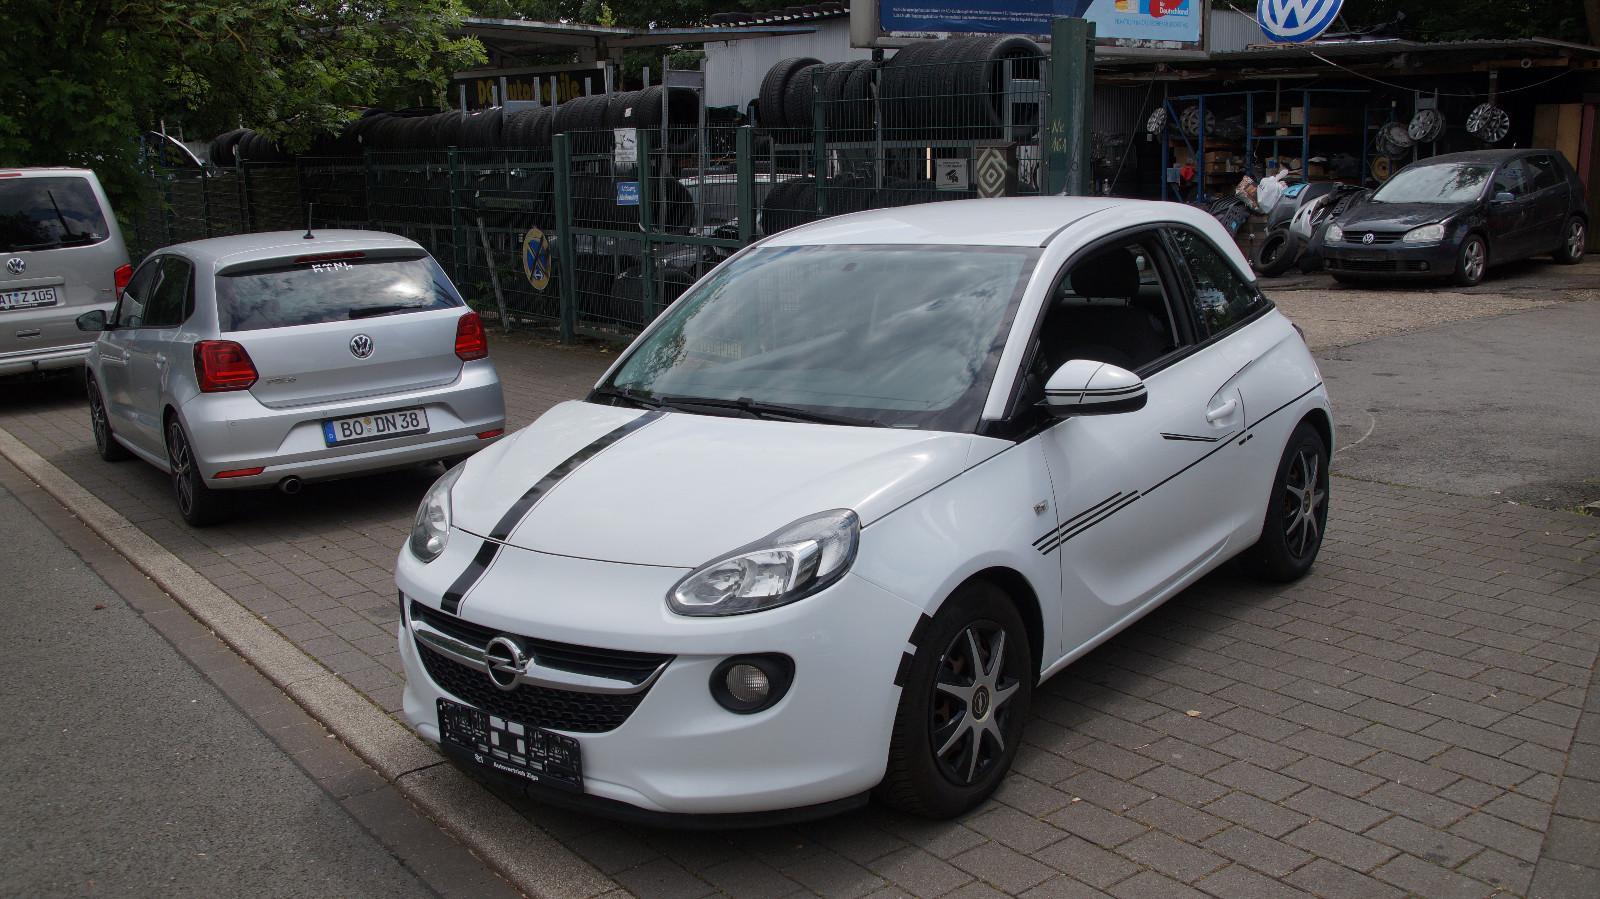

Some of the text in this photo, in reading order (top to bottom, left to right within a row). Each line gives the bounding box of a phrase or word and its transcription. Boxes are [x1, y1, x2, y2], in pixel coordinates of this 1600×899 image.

[31, 289, 54, 302] 105
[340, 412, 420, 438] BO DN 38
